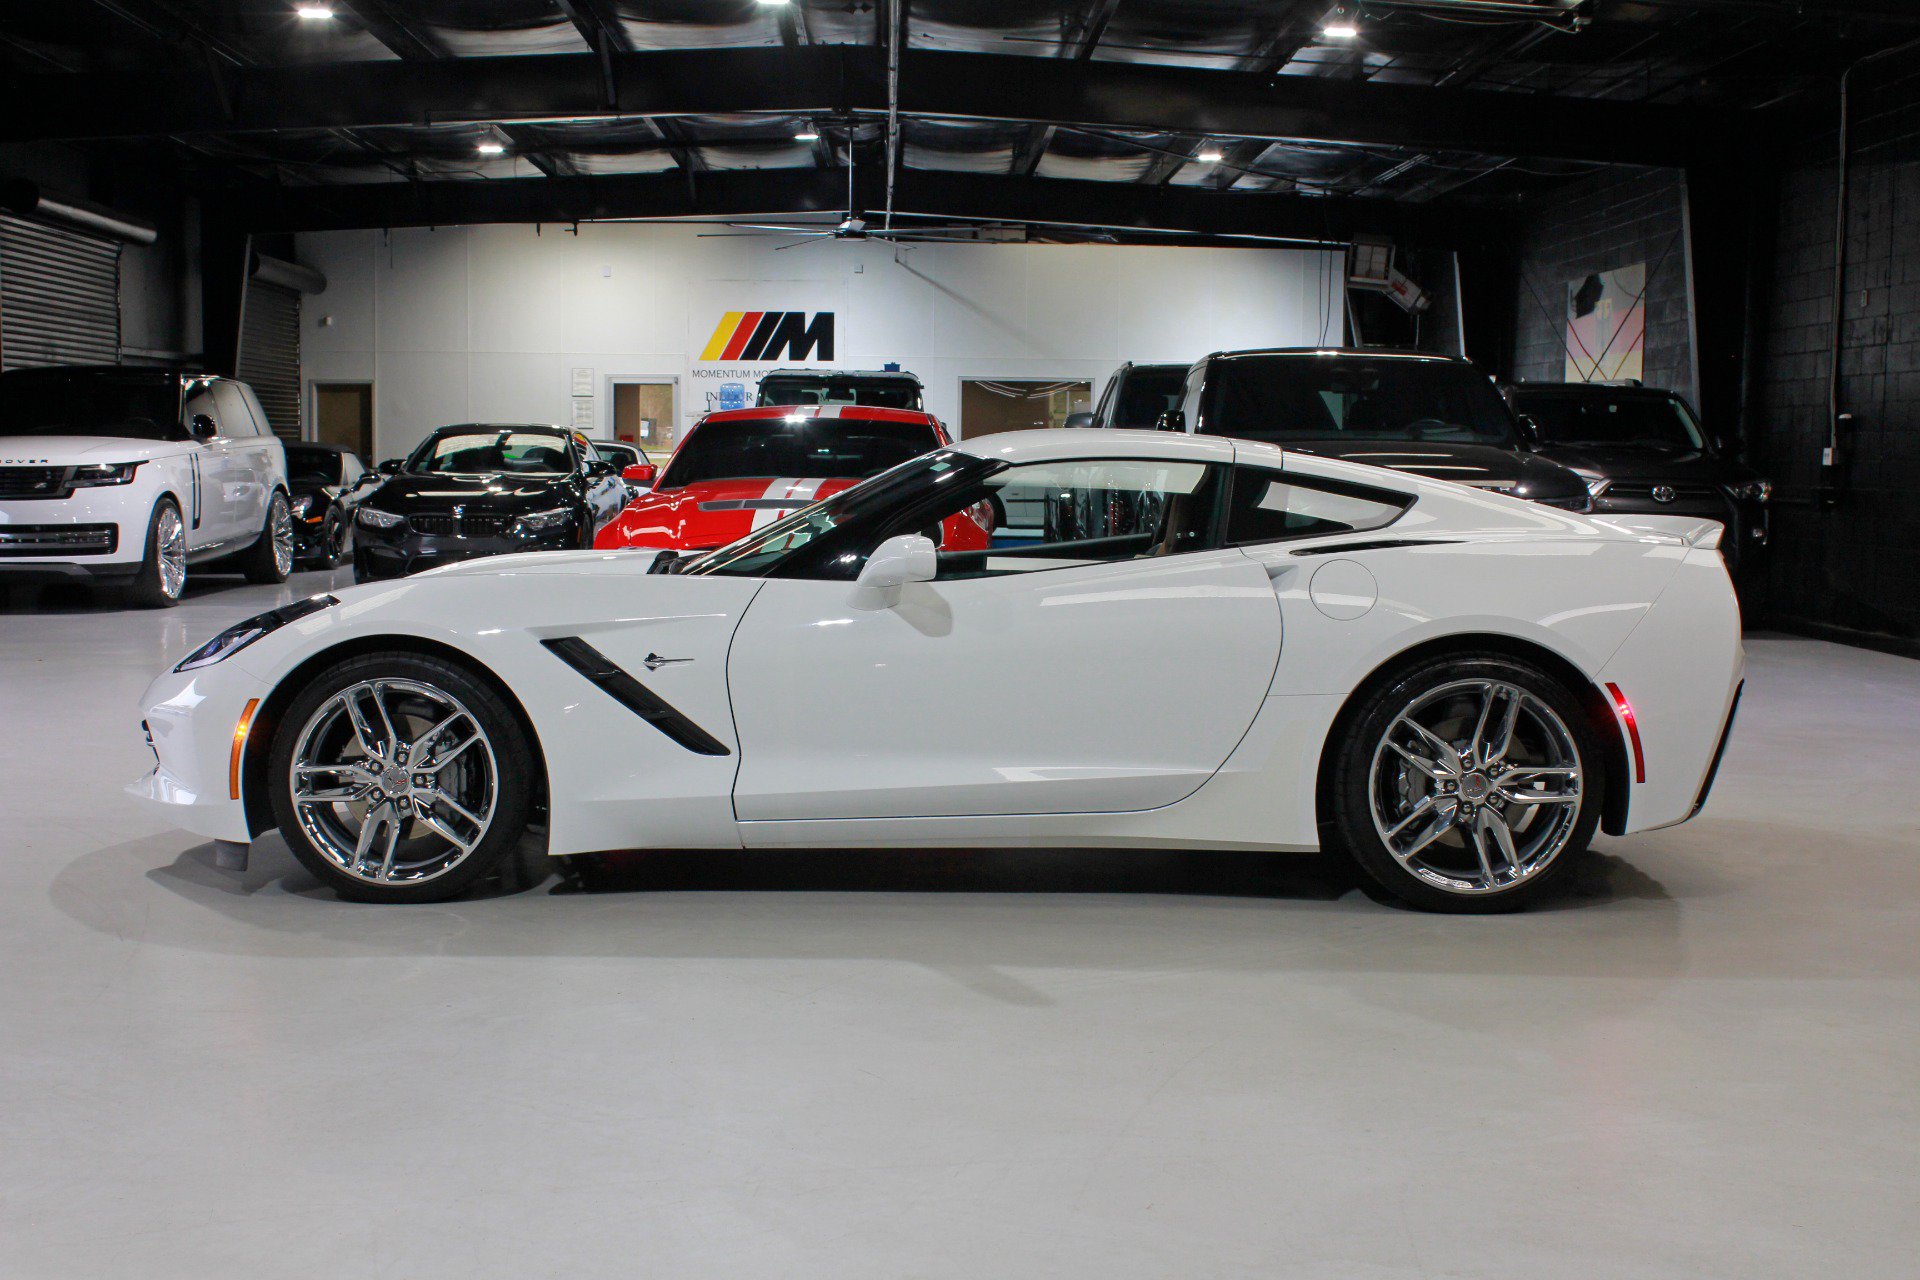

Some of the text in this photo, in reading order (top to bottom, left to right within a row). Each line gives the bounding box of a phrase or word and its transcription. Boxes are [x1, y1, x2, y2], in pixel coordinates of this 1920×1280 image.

[692, 369, 771, 379] MOMENTUM MO
[705, 391, 753, 402] INR
